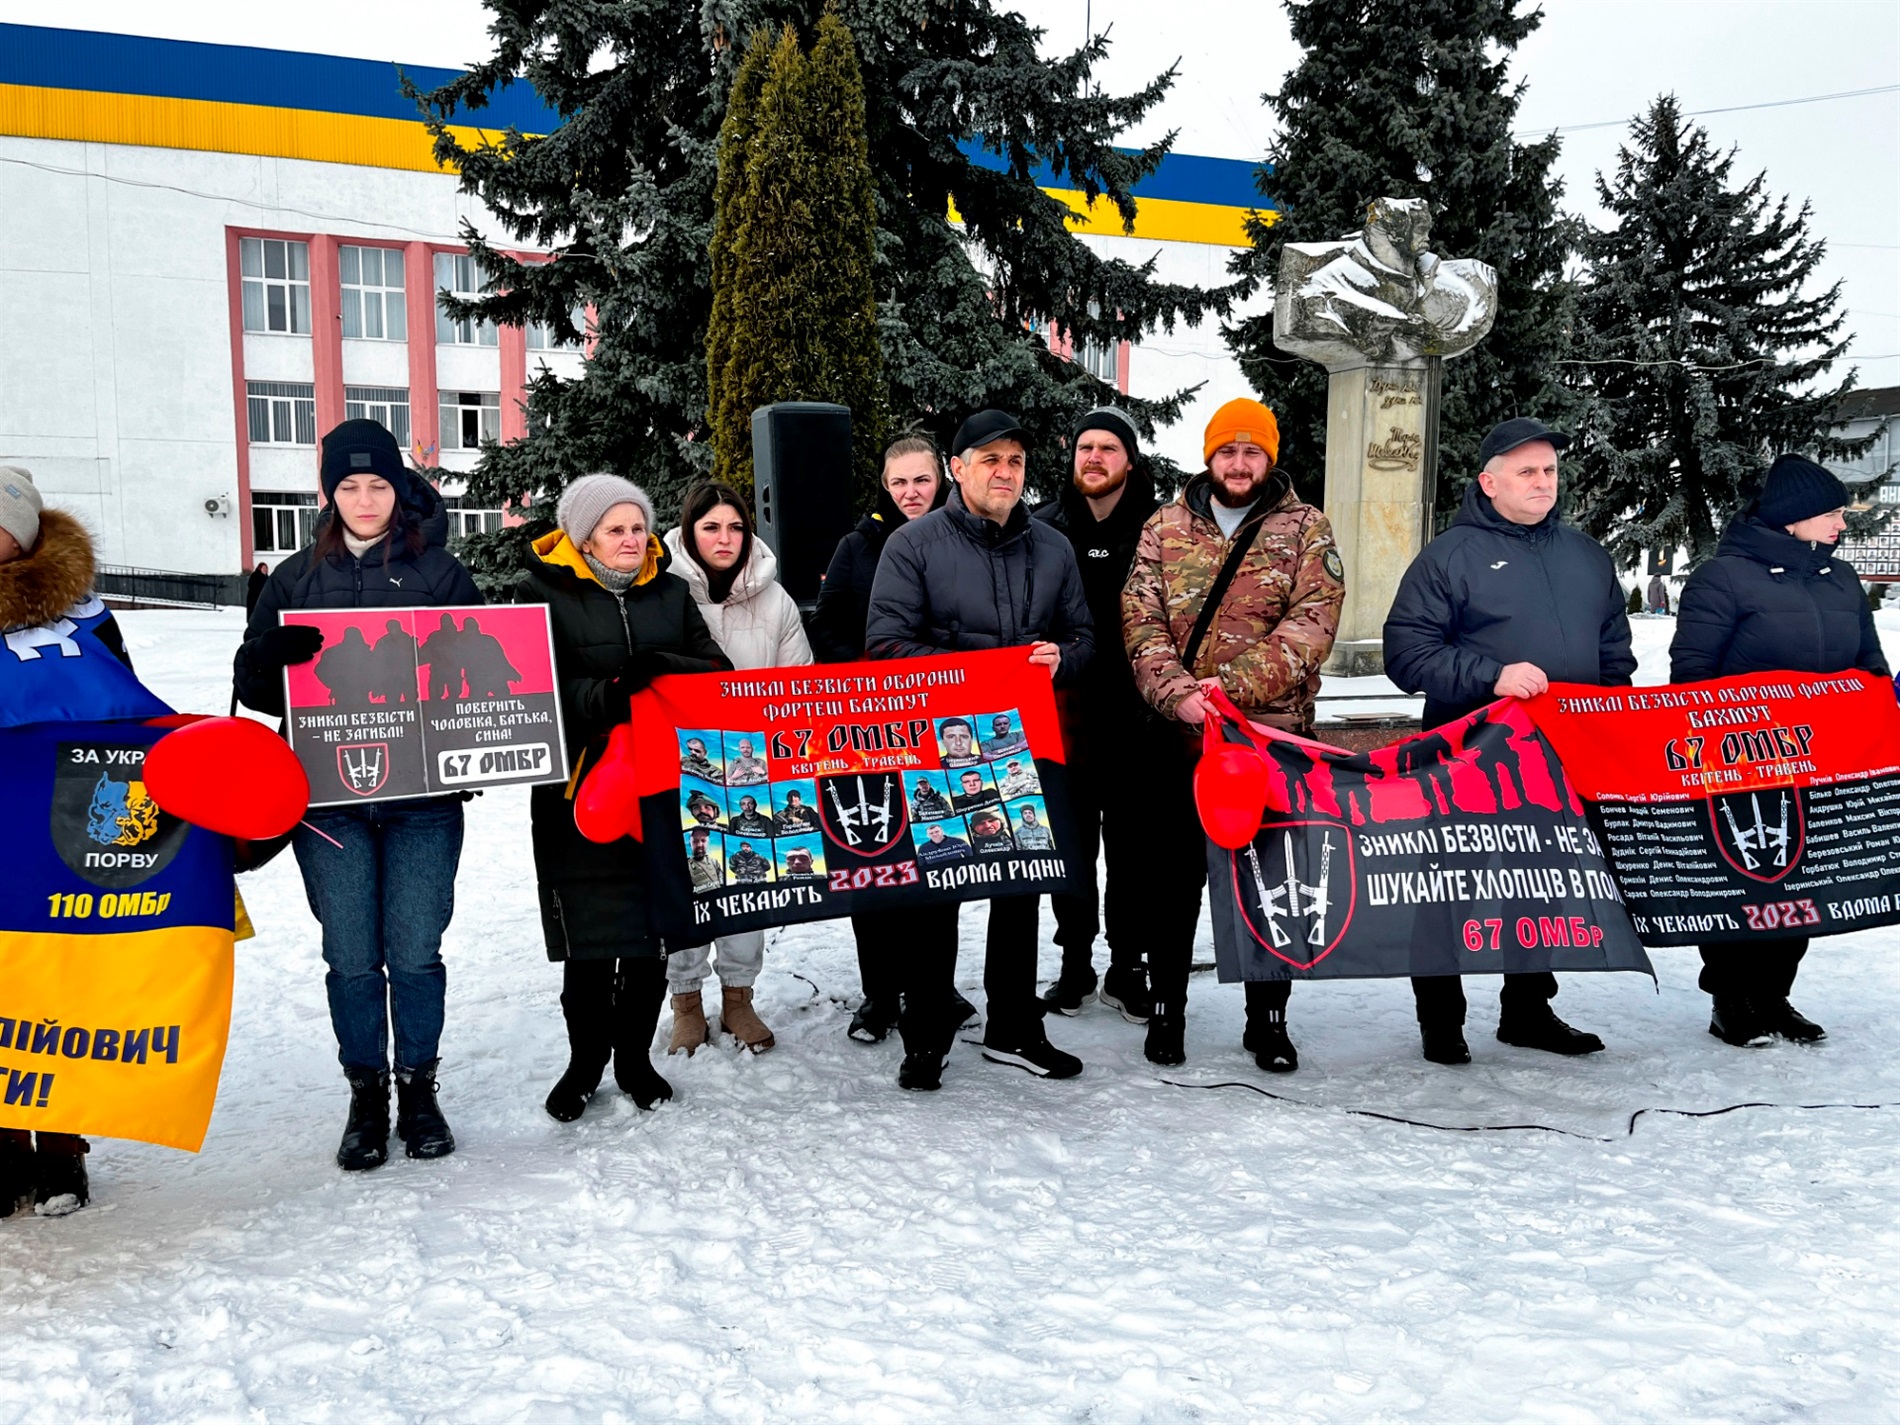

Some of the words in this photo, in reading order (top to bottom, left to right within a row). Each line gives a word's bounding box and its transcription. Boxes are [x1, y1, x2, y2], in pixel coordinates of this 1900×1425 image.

[720, 681, 784, 698] ЗНИКЛІ
[791, 677, 877, 697] БЕЗВІСТИ
[883, 669, 966, 691] ОБОРОНЦІ
[1557, 696, 1623, 713] ЗНИКЛІ
[1628, 689, 1714, 711] БЕЗВІСТИ
[1717, 683, 1796, 703] ОБОРОНЦІ
[1798, 678, 1865, 700] ФОРТЕЦІ
[456, 699, 525, 715] ПОВЕРНІТЬ
[763, 701, 843, 722] ФОРТЕЦІ
[849, 692, 929, 713] БАХМУТ
[1688, 705, 1772, 729] БАХМУТ
[299, 712, 348, 729] ЗНИКЛІ
[351, 710, 415, 726] БЕЗВІСТИ
[431, 715, 497, 731] ЧОЛОВІКА,
[499, 711, 553, 727] БАТЬКА,
[324, 730, 342, 742] НЕ
[345, 725, 404, 741] ЗАГИБЛІ!
[475, 730, 512, 743] СИНА!
[771, 729, 813, 760] 67
[827, 719, 928, 753] ОМБР
[71, 748, 100, 764] ЗА
[105, 749, 146, 765] УКР
[1665, 736, 1705, 771] 67
[1720, 724, 1814, 765] ОМБР
[444, 754, 472, 778] 67
[791, 760, 849, 775] КВІТЕНЬ
[862, 754, 922, 768] ТРАВЕНЬ
[1681, 767, 1743, 787] КВІТЕНЬ
[1756, 759, 1817, 779] ТРАВЕНЬ
[1650, 792, 1690, 802] Юрійович
[1835, 785, 1870, 796] Олександр
[1651, 806, 1695, 815] Семенович
[1359, 828, 1439, 857] ЗНИКЛІ
[1441, 824, 1541, 853] БЕЗВІСТИ
[1553, 825, 1583, 854] НЕ
[1607, 833, 1634, 842] Росада
[1842, 827, 1871, 838] Василь
[1807, 842, 1864, 859] Березовський
[1865, 839, 1890, 849] Роман
[85, 852, 159, 868] ПОРВУ
[1842, 854, 1886, 868] Володимир
[1367, 862, 1470, 906] ШУКАЙТЕ
[1471, 868, 1567, 904] ХЛОПЦІВ
[1568, 868, 1585, 898] В
[1836, 870, 1880, 883] Олександр
[694, 901, 710, 925] ЇХ
[717, 886, 823, 918] ЧЕКАЮТЬ
[828, 860, 919, 892] 2023
[926, 862, 1002, 890] ВДОМА
[1009, 859, 1067, 884] РІДНІ!
[1650, 889, 1689, 899] Олександр
[48, 893, 90, 918] 110
[99, 891, 171, 917] ОМБр
[1652, 913, 1740, 933] ЧЕКАЮТЬ
[1741, 898, 1821, 932] 2023
[1827, 896, 1892, 921] ВДОМА
[1462, 918, 1502, 952] 67
[1515, 916, 1604, 950] ОМБр
